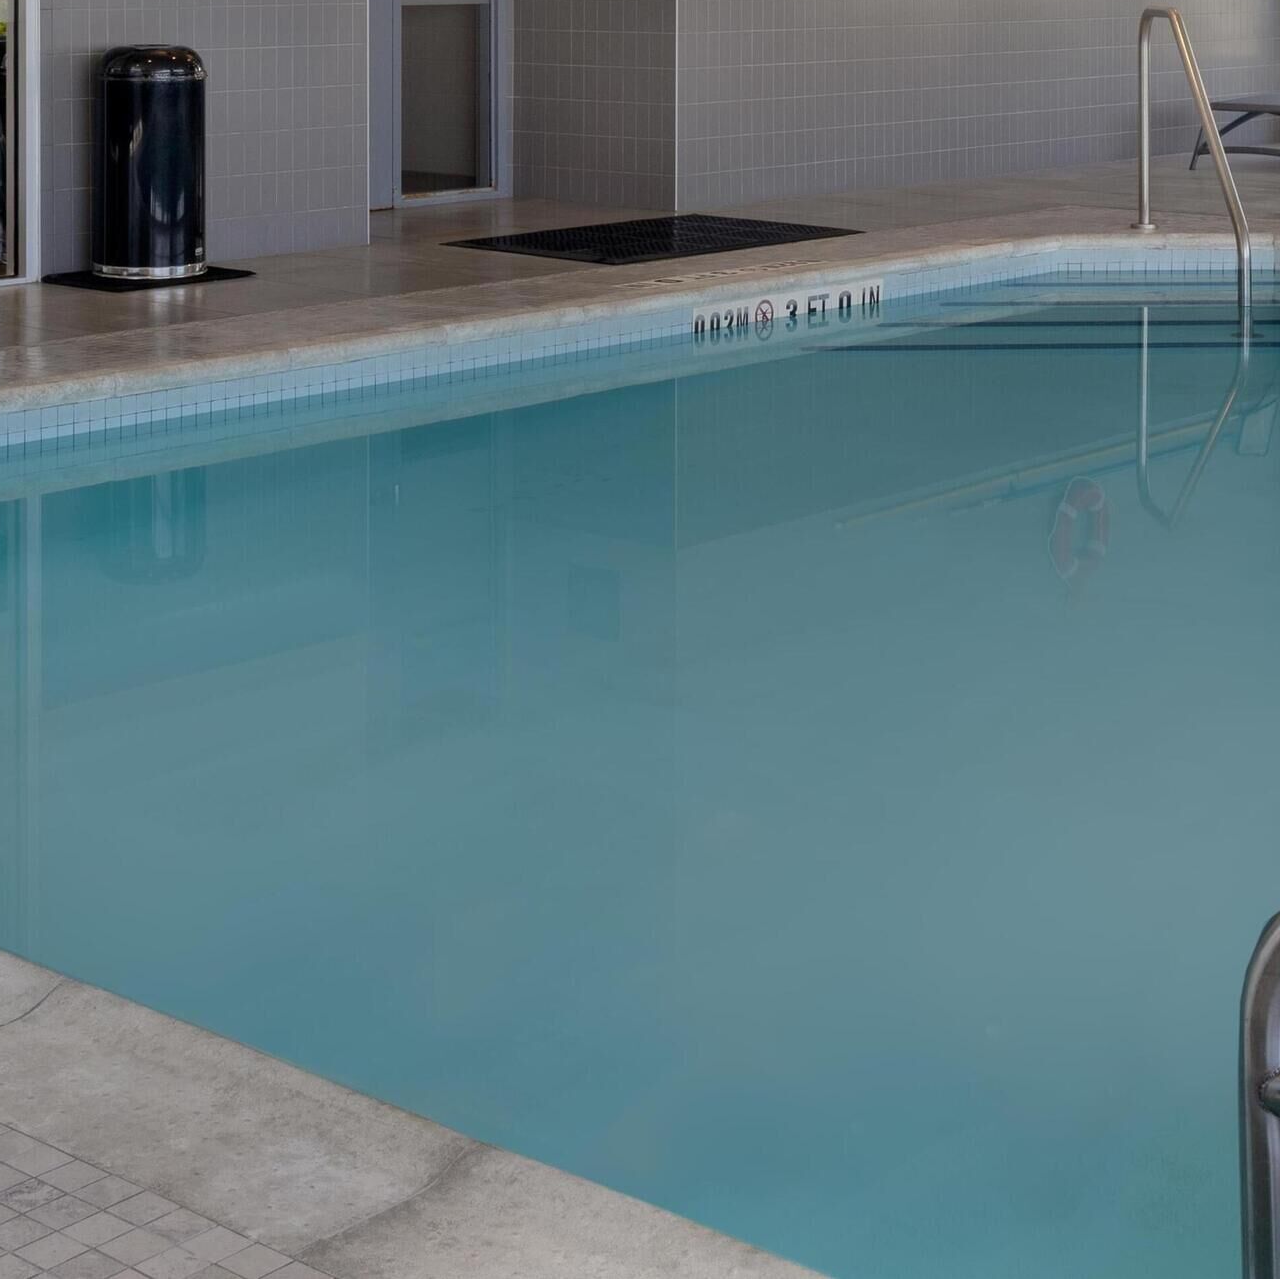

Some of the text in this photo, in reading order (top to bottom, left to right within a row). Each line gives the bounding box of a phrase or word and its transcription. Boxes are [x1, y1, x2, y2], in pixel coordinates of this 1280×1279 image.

[786, 299, 798, 318] 3
[807, 293, 830, 315] FT
[862, 285, 880, 307] IN
